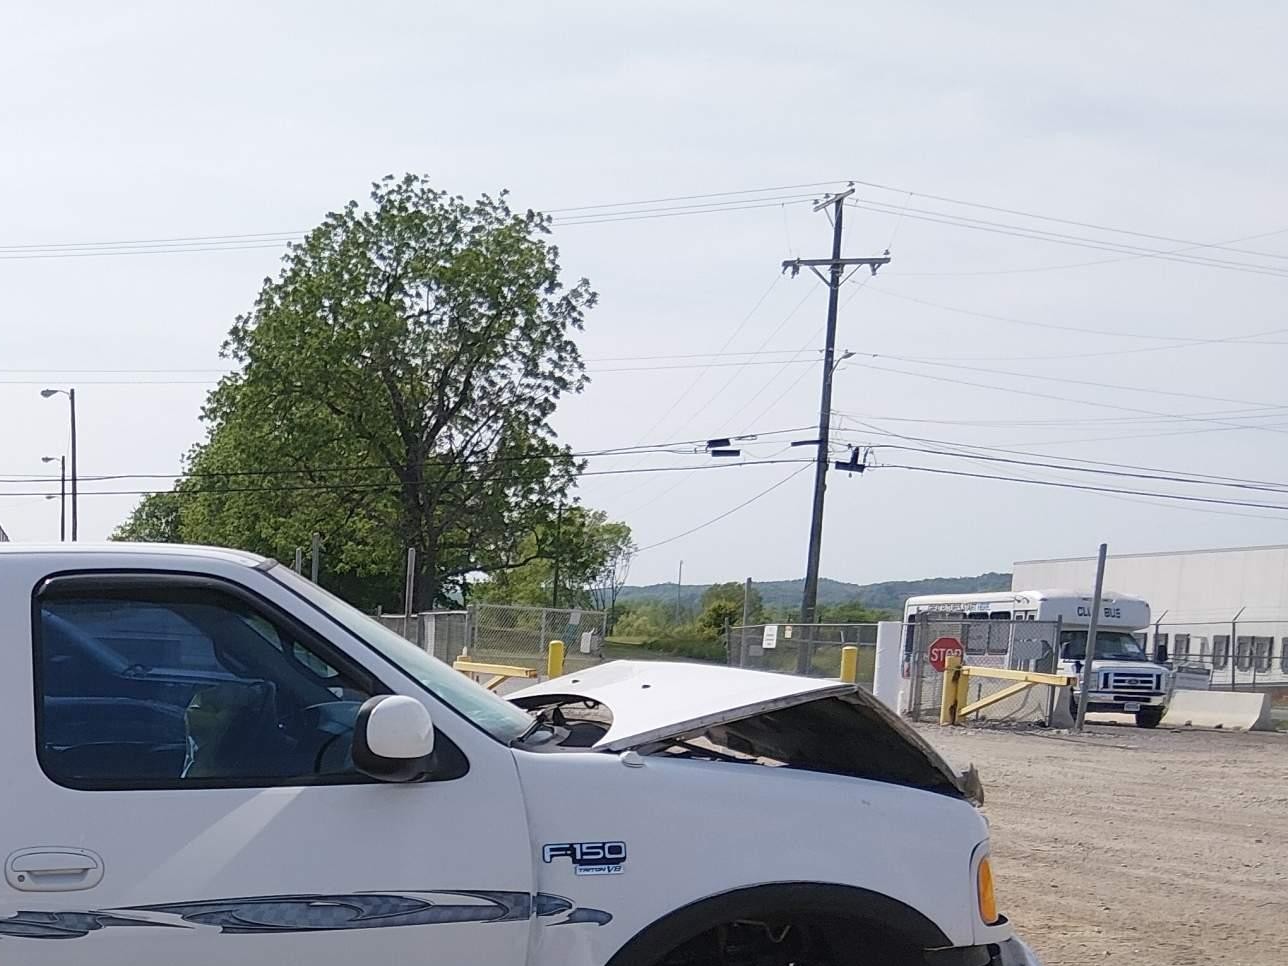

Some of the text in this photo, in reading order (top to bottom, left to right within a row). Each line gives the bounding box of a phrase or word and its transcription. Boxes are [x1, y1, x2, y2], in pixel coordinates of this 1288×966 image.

[1104, 607, 1121, 619] BUS
[930, 648, 962, 662] STOP
[607, 865, 621, 873] V8
